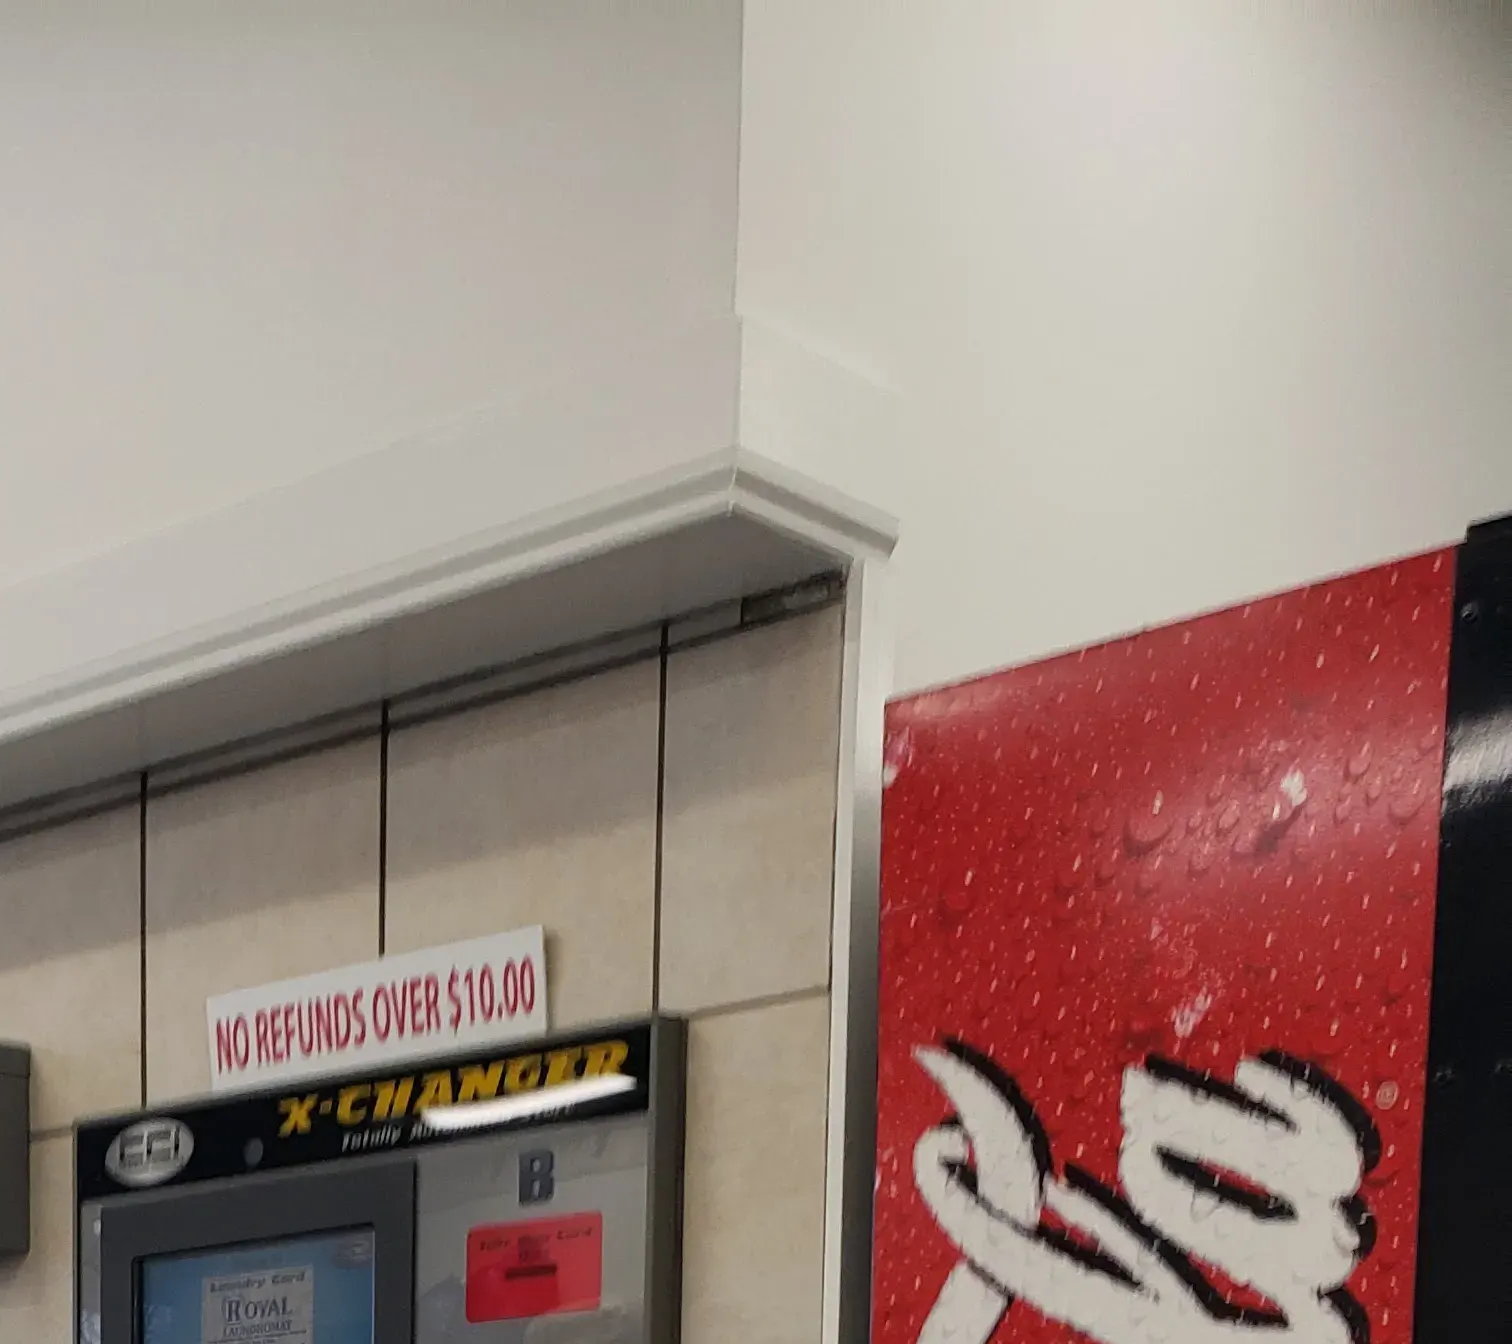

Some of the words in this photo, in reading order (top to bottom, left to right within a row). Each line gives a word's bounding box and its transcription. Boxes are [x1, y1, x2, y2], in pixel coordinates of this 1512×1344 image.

[216, 1012, 250, 1075] NO
[256, 986, 367, 1068] REFUNDS
[373, 973, 441, 1044] OVER
[448, 953, 536, 1037] $10.00
[518, 1151, 555, 1206] B
[223, 1294, 293, 1323] ROYAL
